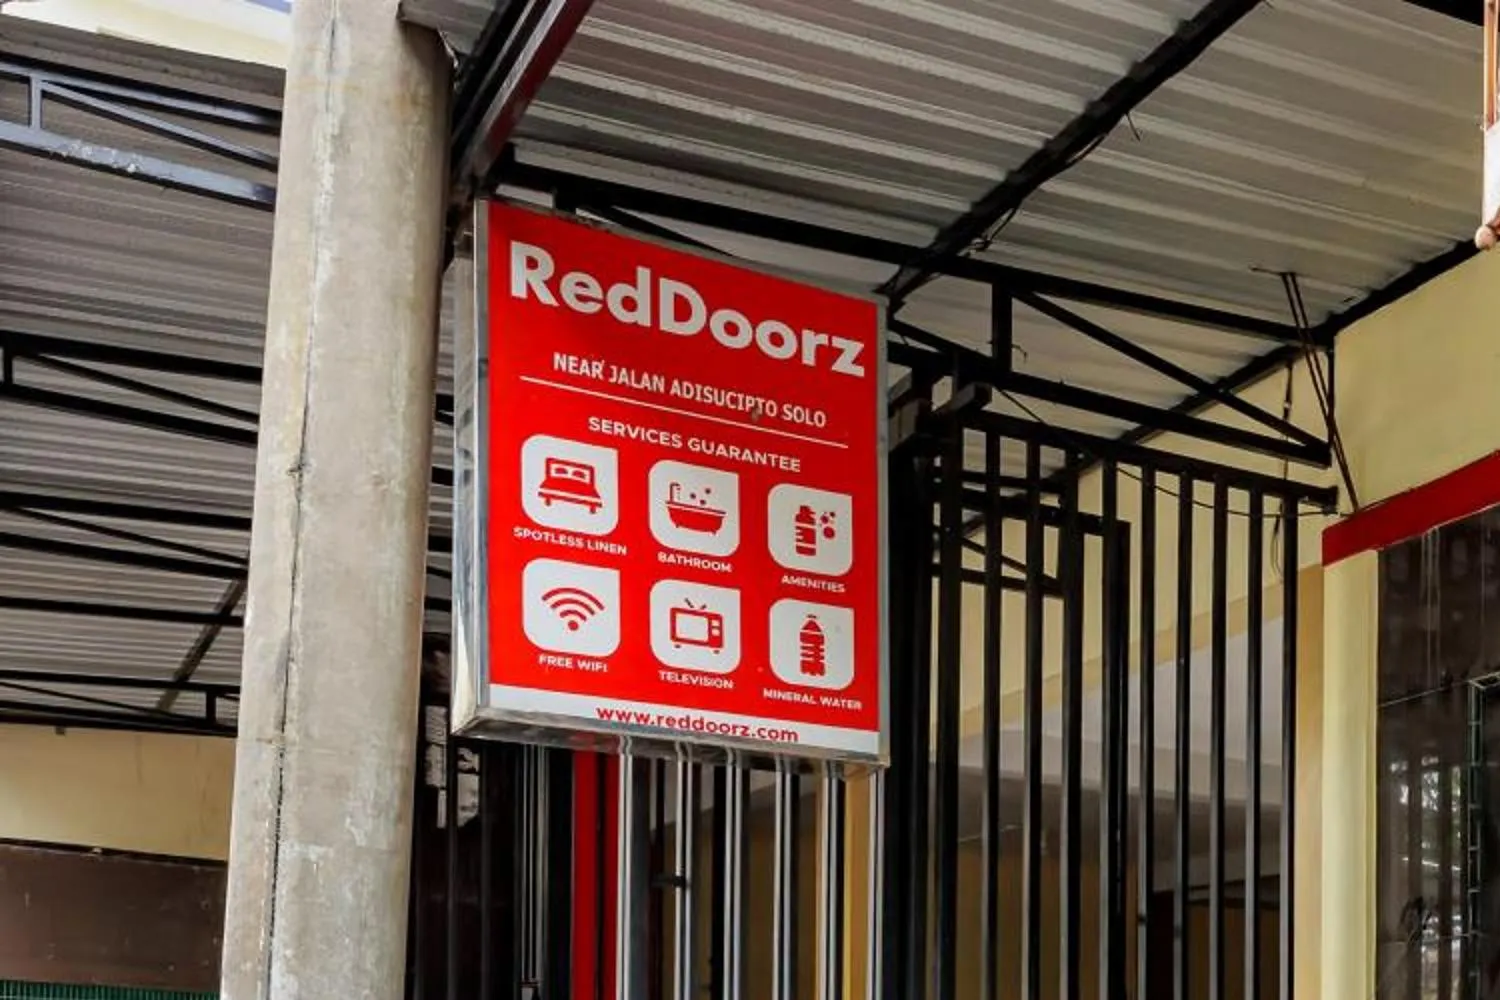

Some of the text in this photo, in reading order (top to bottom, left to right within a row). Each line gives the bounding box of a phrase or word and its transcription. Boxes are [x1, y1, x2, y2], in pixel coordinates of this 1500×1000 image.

[510, 240, 865, 377] RedDoorz
[553, 352, 827, 428] NEAR JALAN ADISUCIPTO SOLO
[588, 416, 801, 473] SERVICES GUARANTEE
[512, 526, 628, 556] SPOTLESS LINEN
[657, 551, 733, 573] BATHROOM
[781, 575, 846, 593] AMENITIES
[539, 654, 609, 673] FREE WIFI
[659, 670, 734, 689] TELEVISION
[763, 687, 862, 711] MINERAL WATER
[595, 705, 800, 743] www.reddoorz.com
